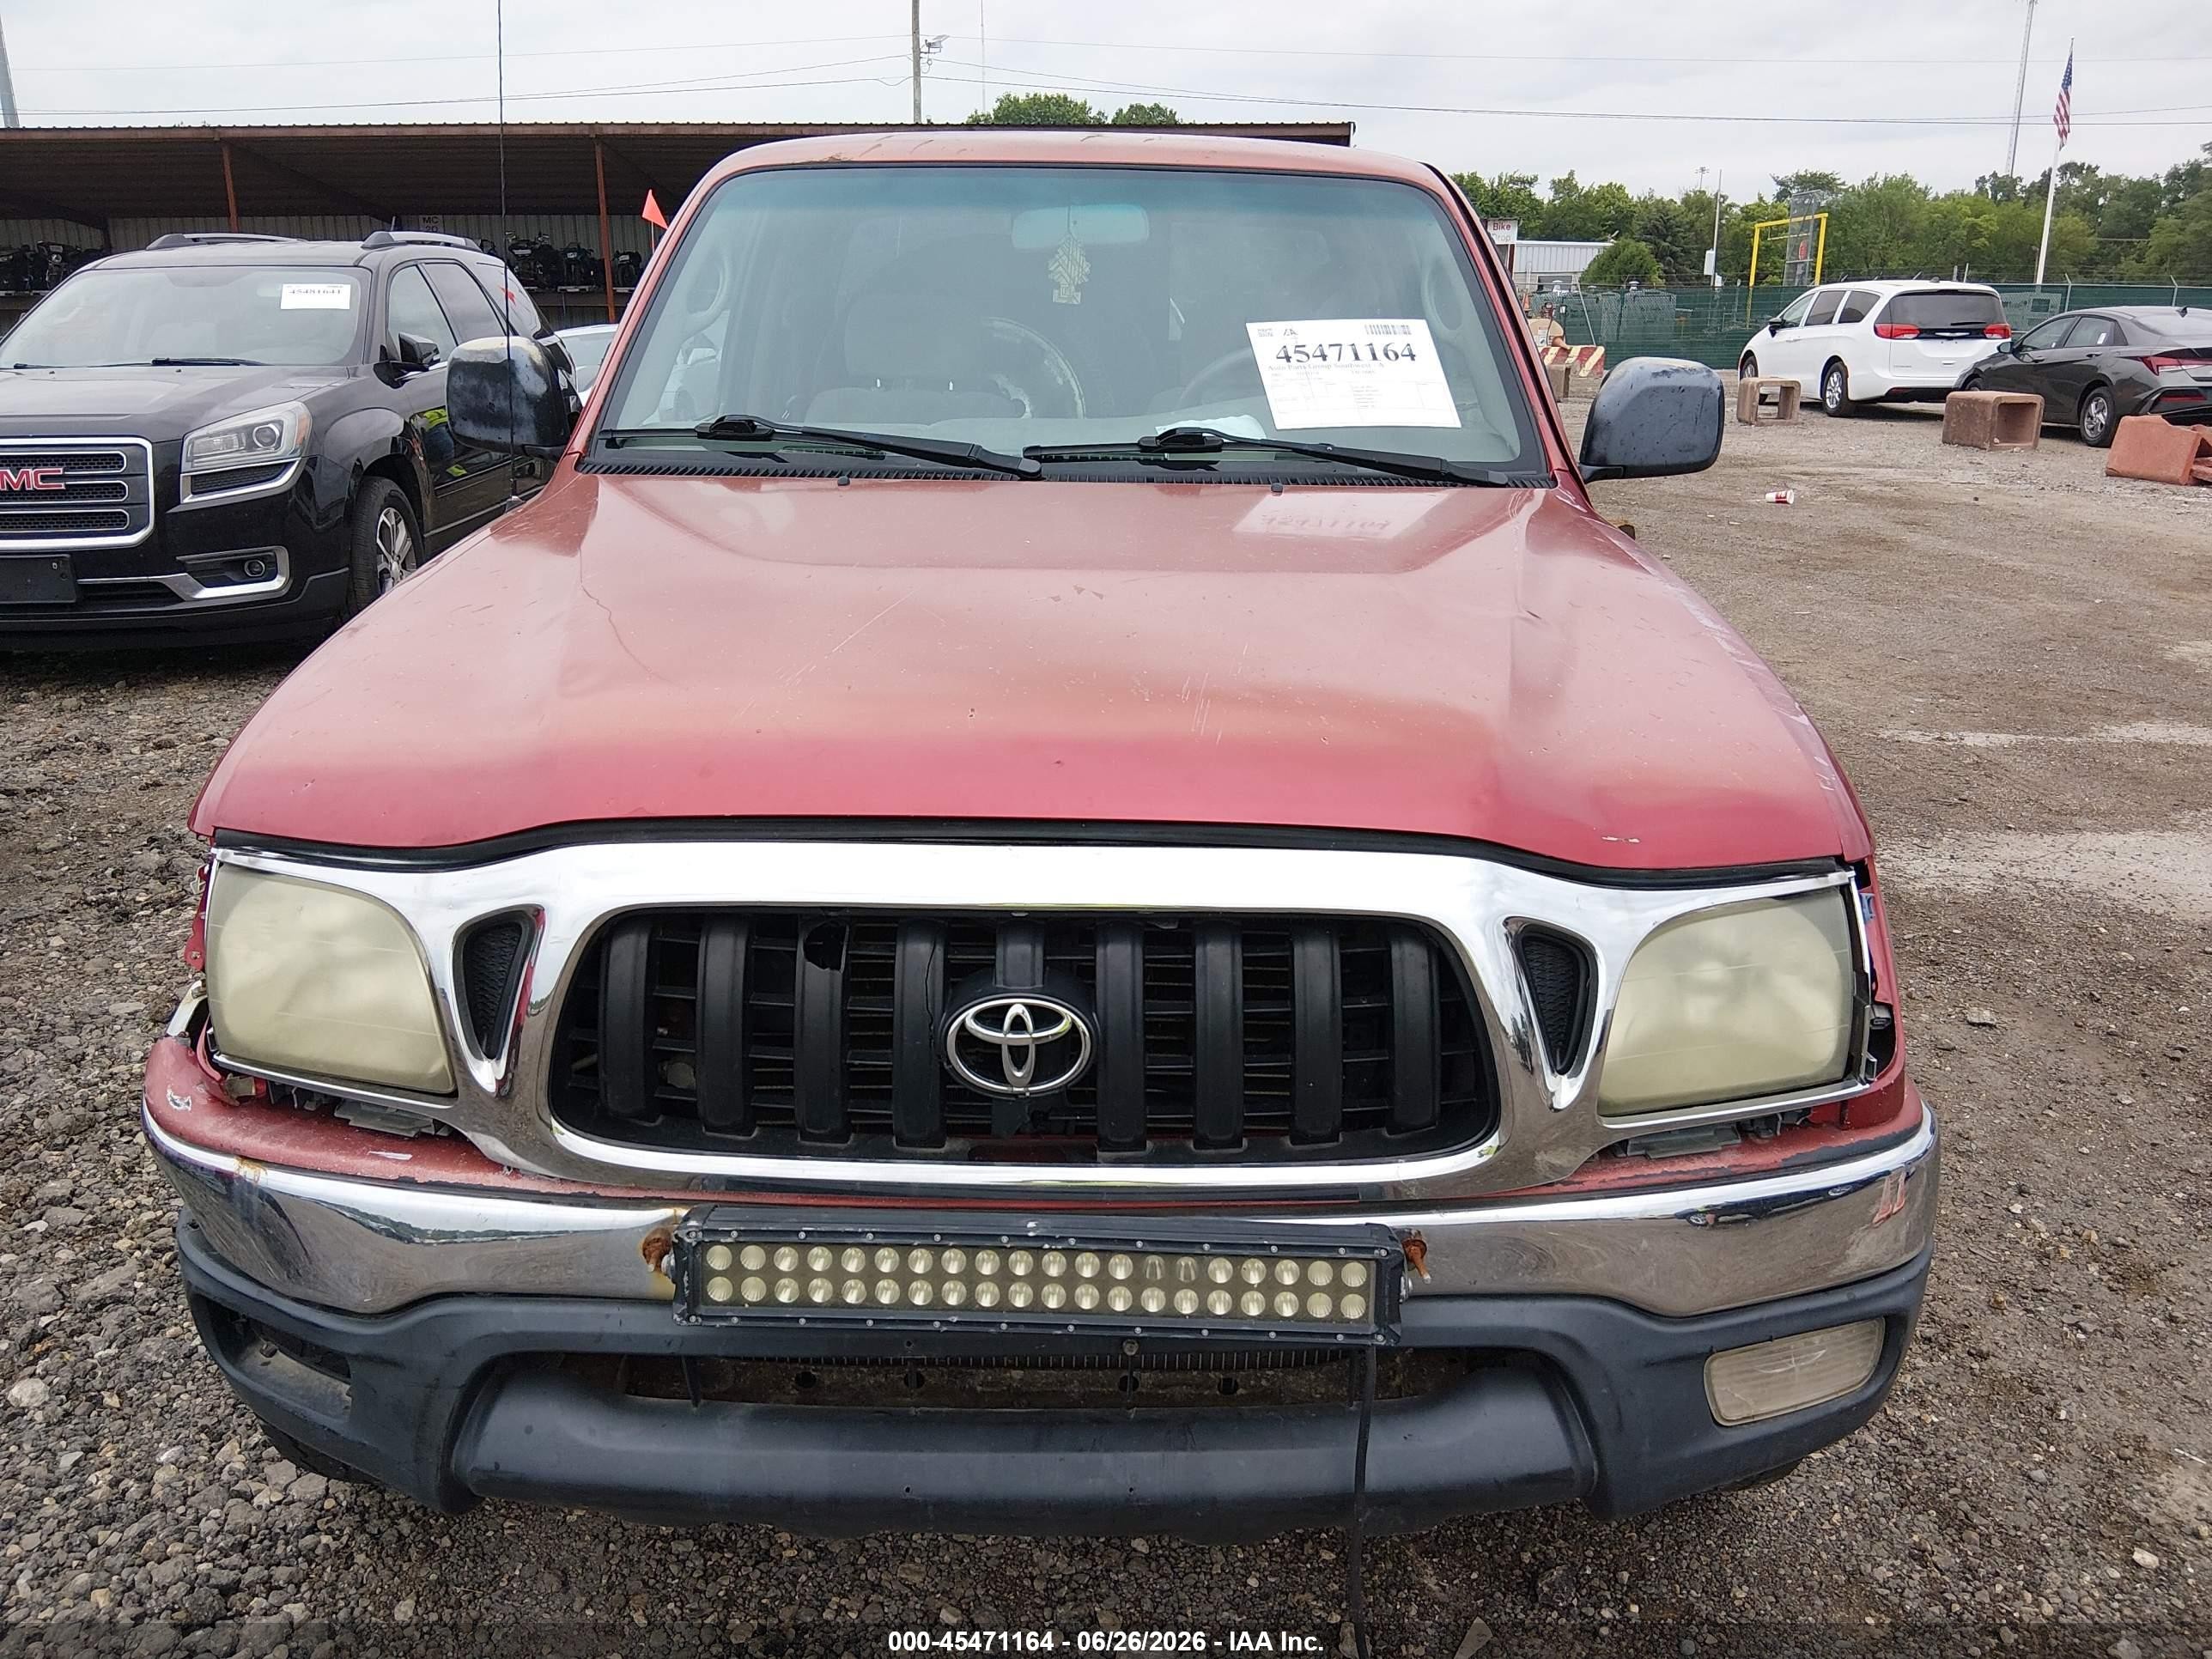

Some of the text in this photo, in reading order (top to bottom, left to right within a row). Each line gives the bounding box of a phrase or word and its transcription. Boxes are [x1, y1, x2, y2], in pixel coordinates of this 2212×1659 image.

[422, 216, 439, 224] MC
[1492, 222, 1511, 231] Bike
[1276, 343, 1416, 363] 45471164
